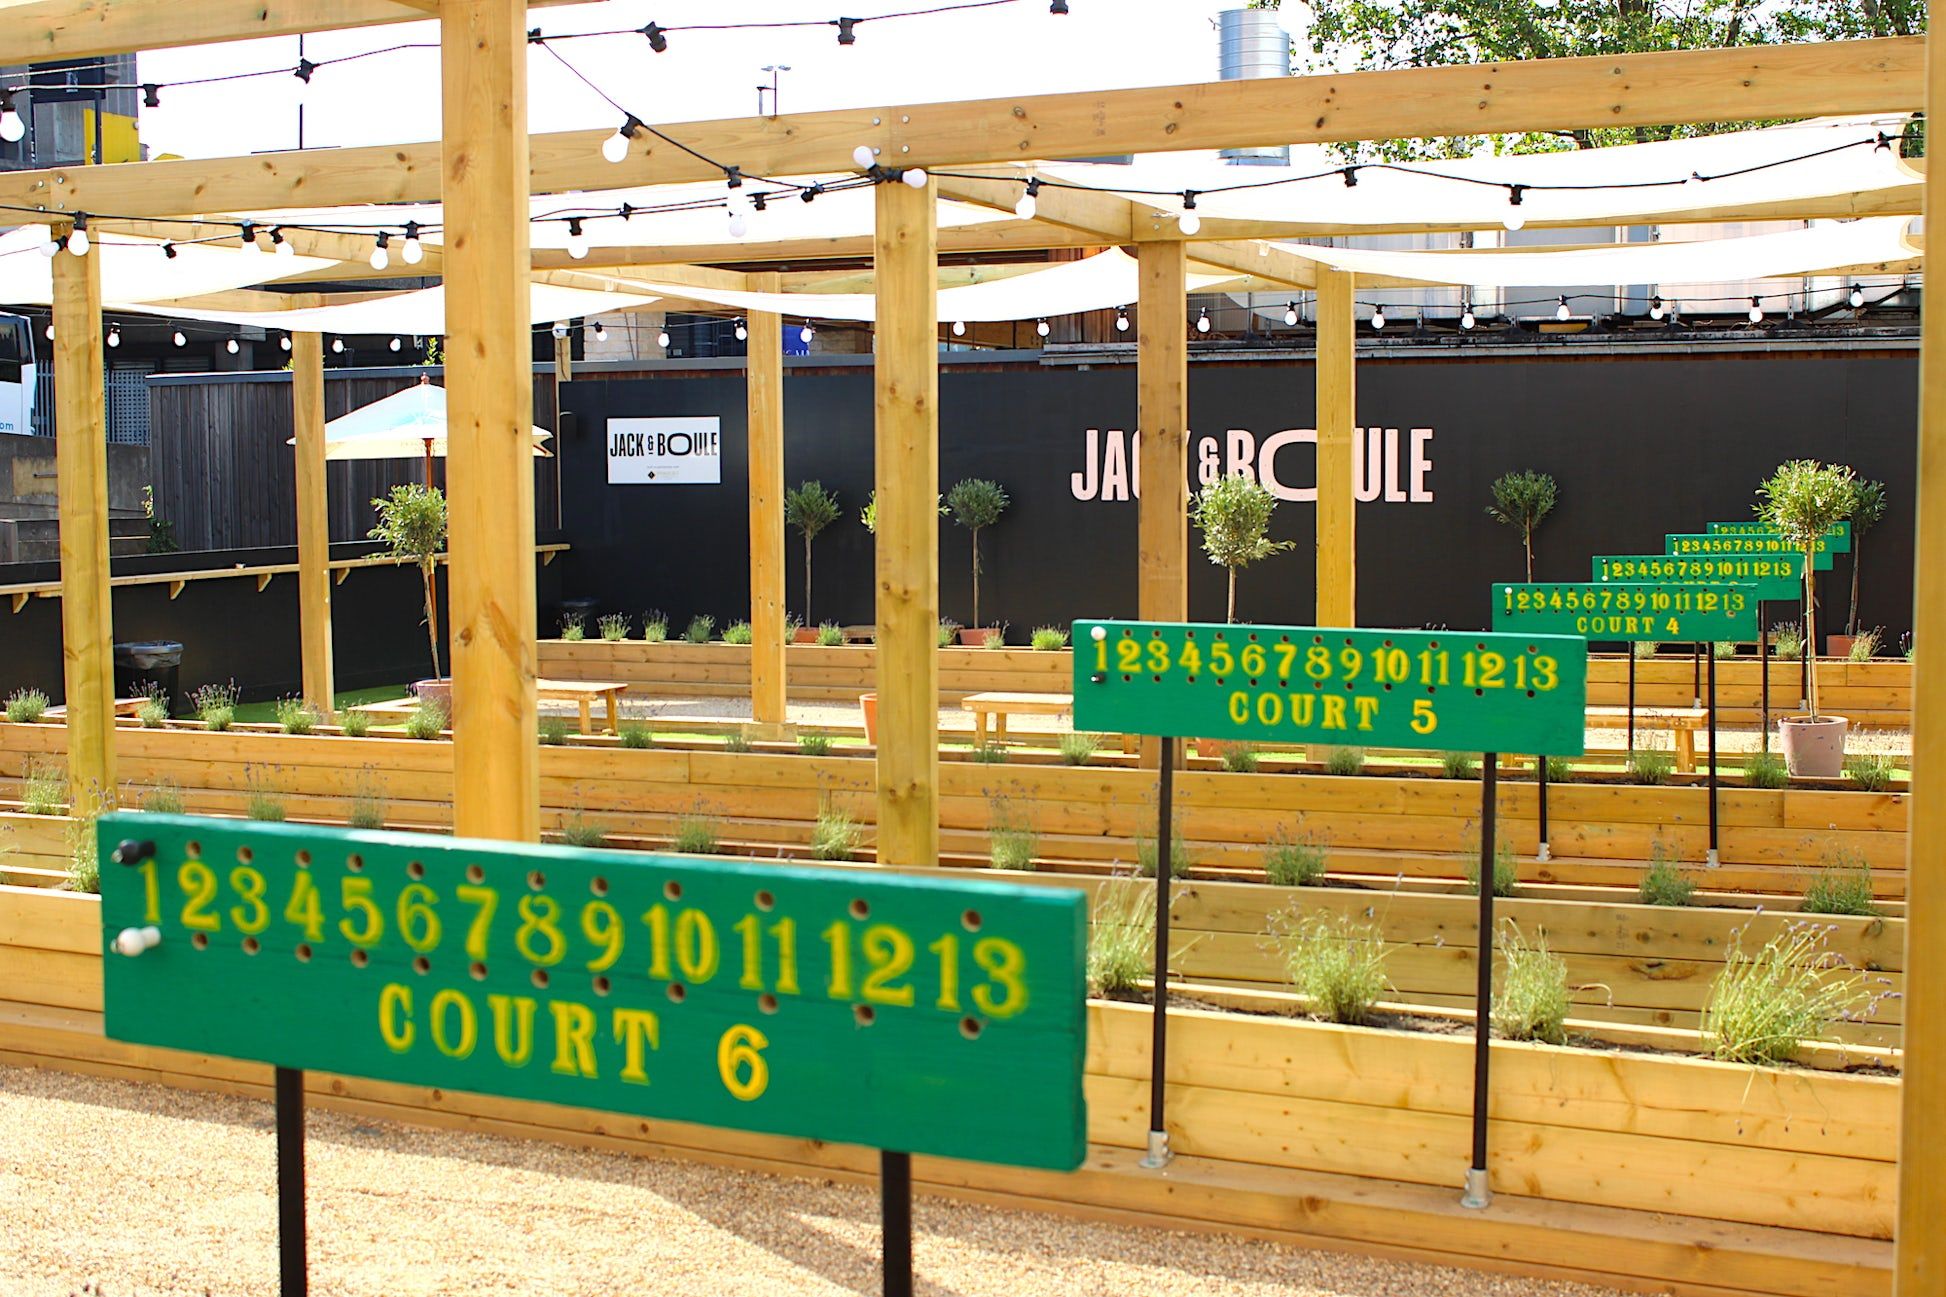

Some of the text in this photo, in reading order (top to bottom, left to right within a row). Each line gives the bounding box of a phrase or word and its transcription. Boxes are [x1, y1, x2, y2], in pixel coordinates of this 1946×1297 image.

[610, 433, 644, 457] JACK
[657, 432, 717, 456] BOULE
[1071, 429, 1192, 501] JA
[1227, 427, 1434, 502] BOULE
[1673, 541, 1679, 552] 1
[1682, 540, 1691, 552] 2
[1692, 540, 1700, 552] 3
[1702, 540, 1711, 552] 4
[1713, 540, 1721, 552] 5
[1723, 540, 1732, 552] 6
[1733, 540, 1742, 552] 7
[1744, 540, 1753, 552] 8
[1755, 540, 1764, 552] 9
[1766, 540, 1779, 552] 10
[1781, 540, 1792, 552] 11
[1602, 562, 1791, 577] 1 2 3 4 5 6 7 8 9 10 11 12 13
[1505, 592, 1745, 610] 1 2 3 4 5 6 7 8 9 10 11 12 13
[1576, 616, 1679, 635] COURT 4
[1094, 639, 1558, 691] 1 2 3 4 5 6 7 8 9 10 11 12 13
[1229, 691, 1437, 734] COURT 5
[138, 859, 1029, 1018] 1 2 3 4 5 6 7 8 9 10 11 12 13
[378, 983, 770, 1101] COURT 6
